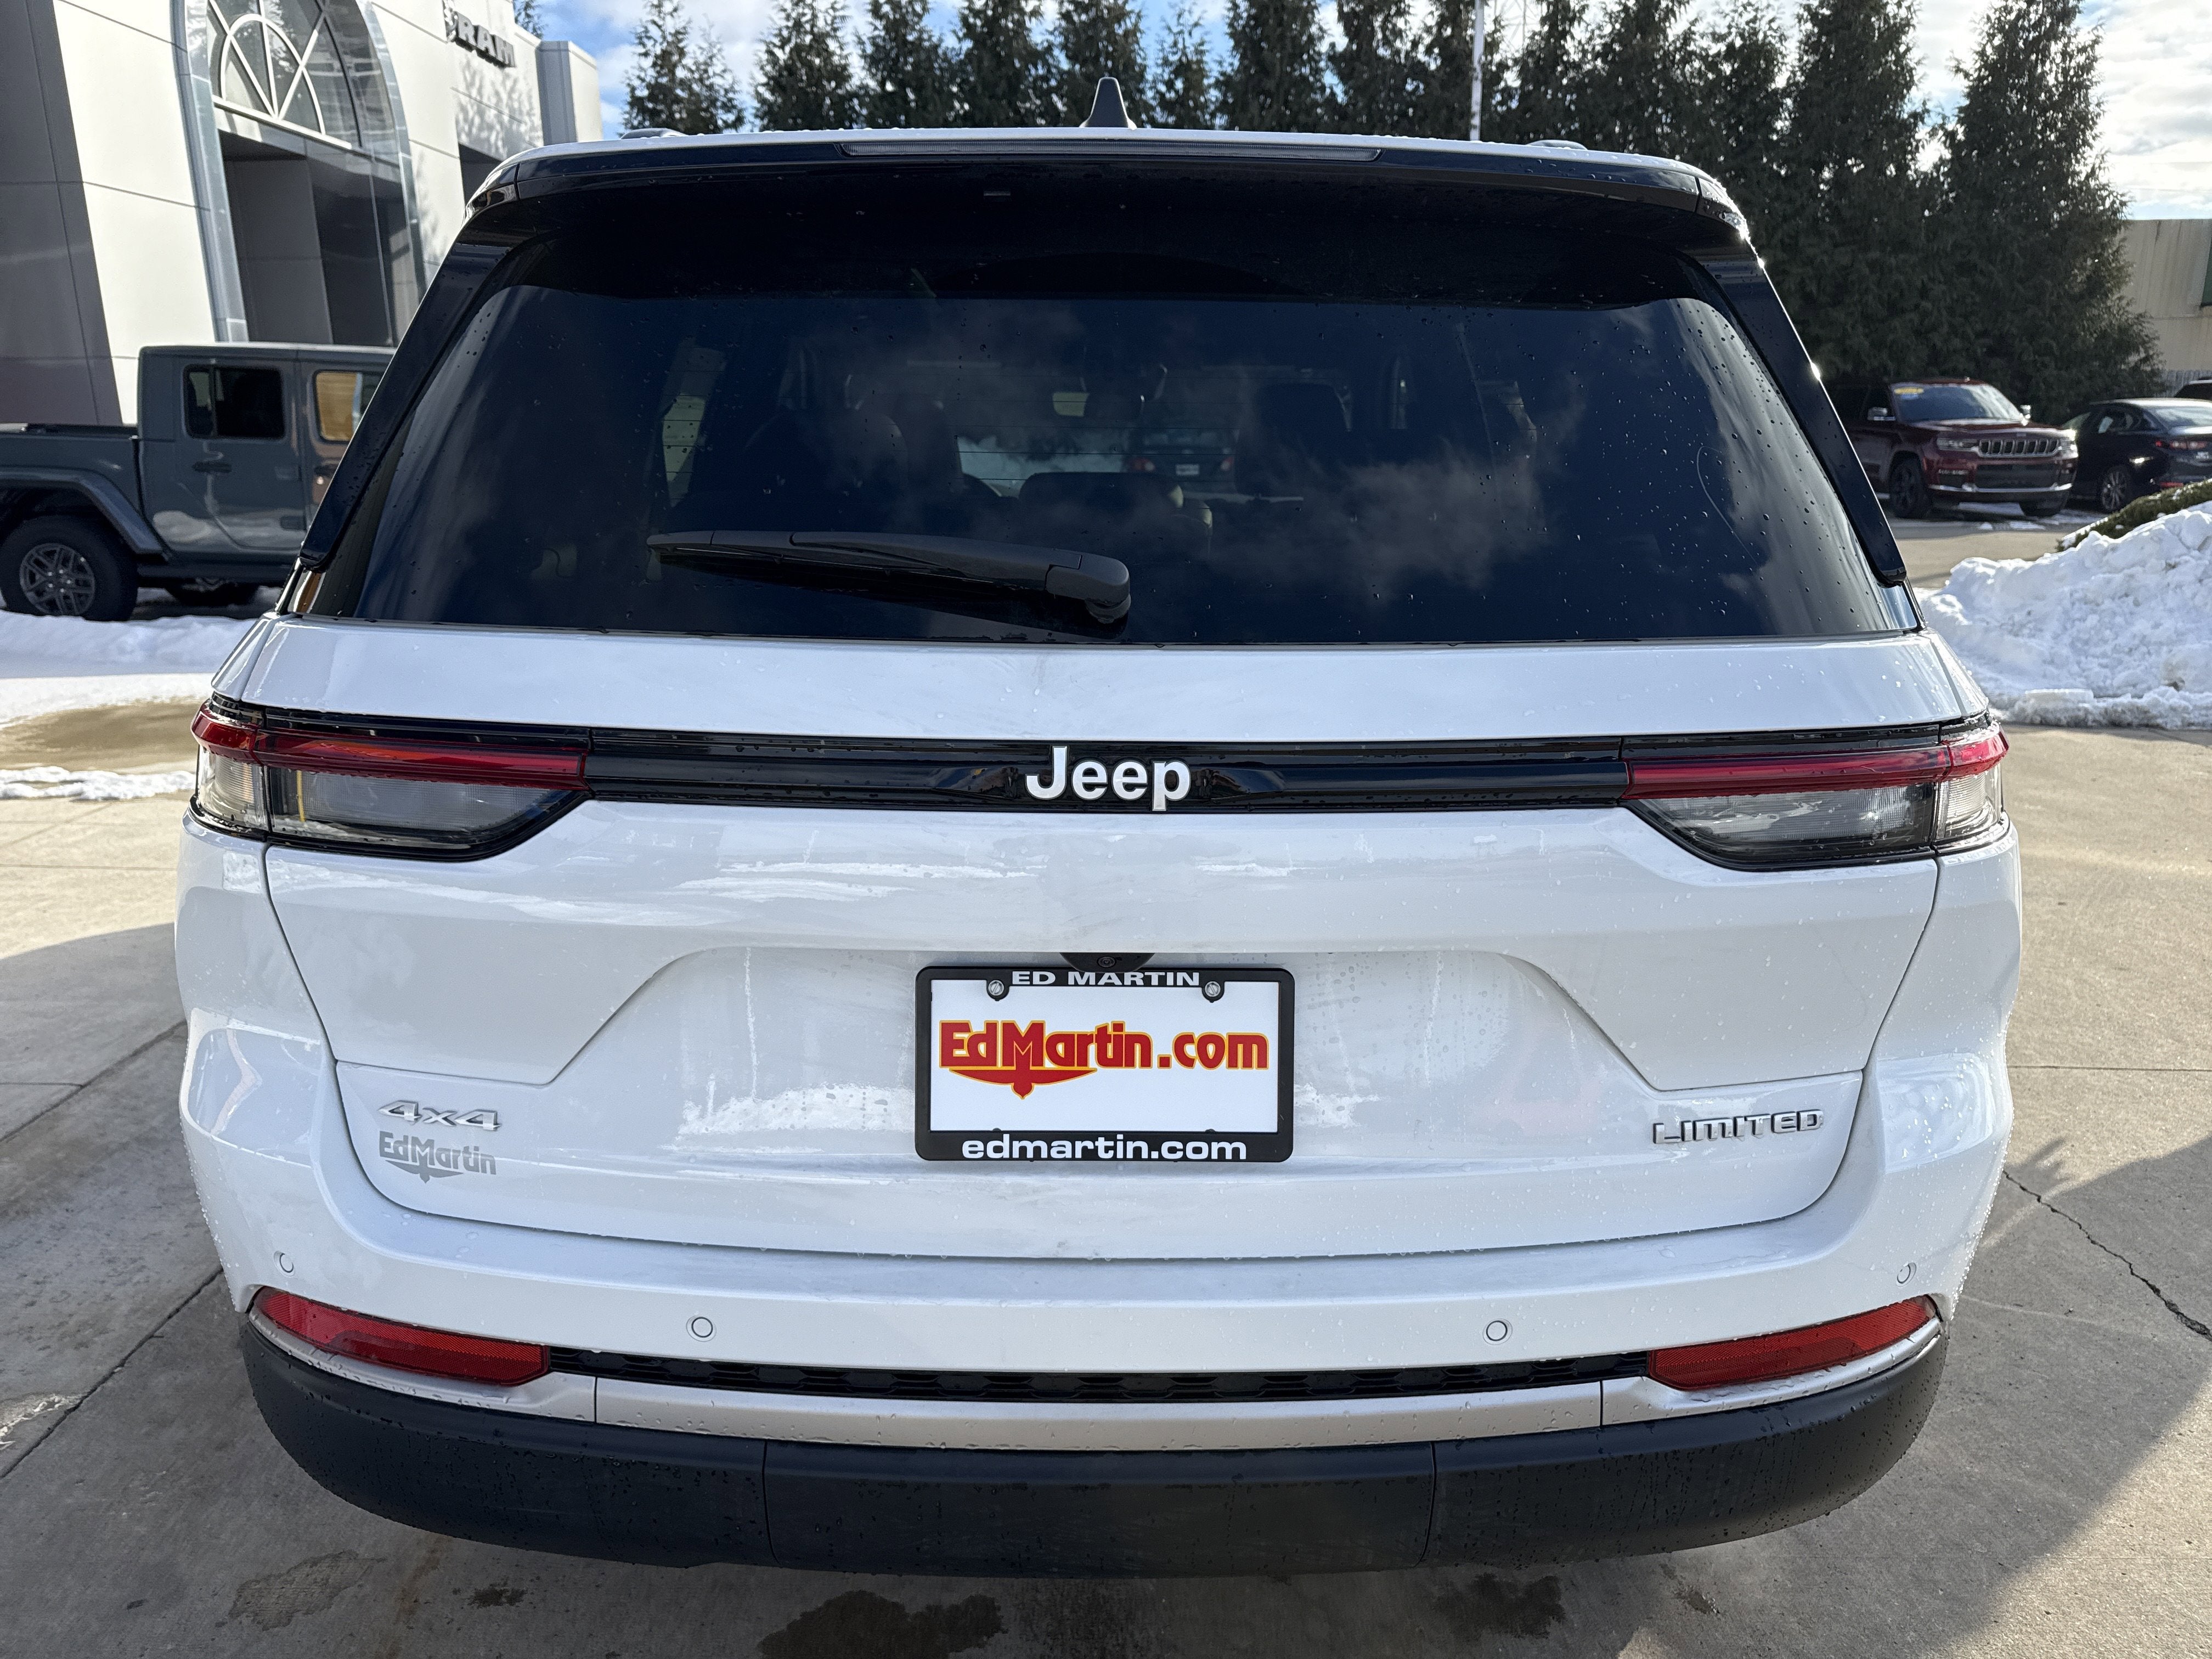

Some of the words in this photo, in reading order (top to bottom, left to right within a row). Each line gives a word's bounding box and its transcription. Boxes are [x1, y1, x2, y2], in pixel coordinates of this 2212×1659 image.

[455, 11, 516, 67] RAM
[1025, 746, 1192, 811] Jeep
[1012, 971, 1057, 986] ED
[1068, 971, 1201, 986] MARTIN
[939, 1020, 1269, 1070] EdMartin.com
[377, 1099, 501, 1131] 4x4
[1652, 1109, 1824, 1144] LIMITED
[379, 1130, 497, 1175] EdMartin
[962, 1134, 1247, 1160] edmartin.com
